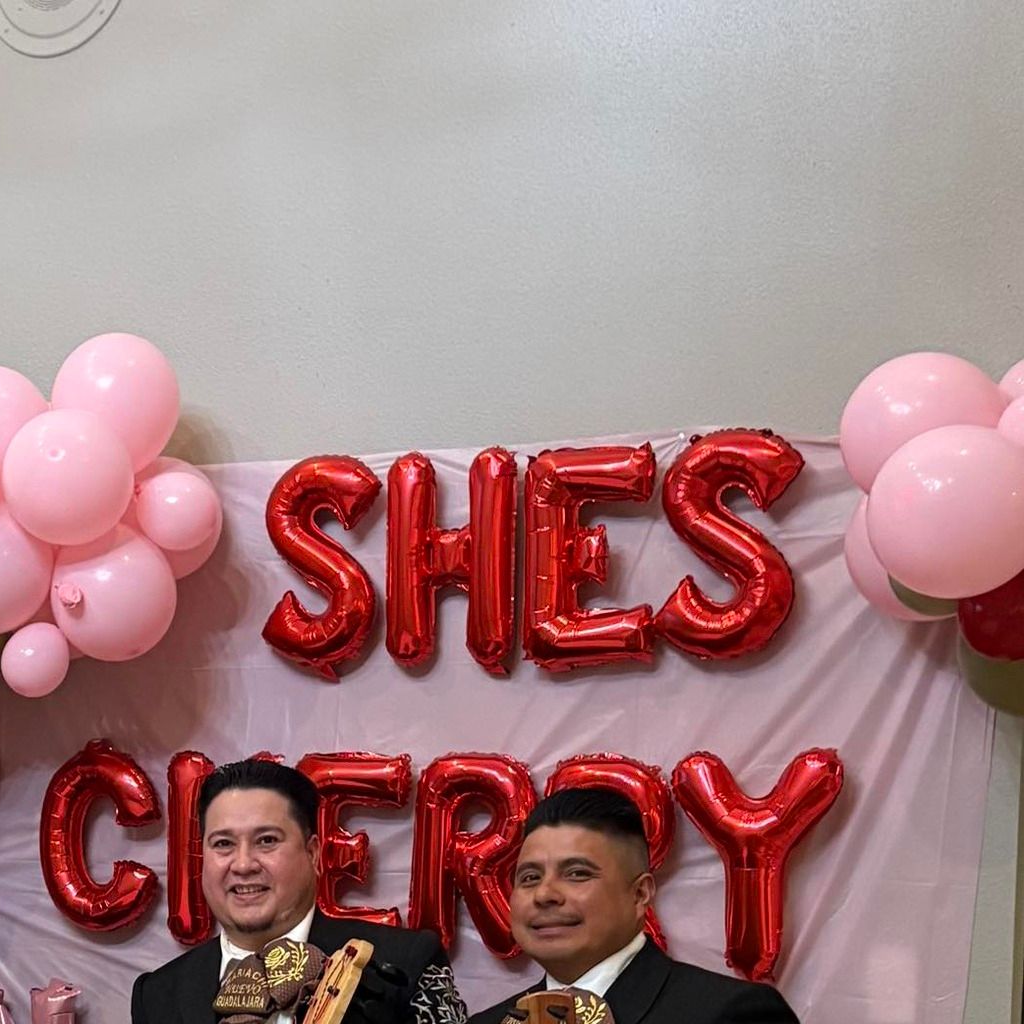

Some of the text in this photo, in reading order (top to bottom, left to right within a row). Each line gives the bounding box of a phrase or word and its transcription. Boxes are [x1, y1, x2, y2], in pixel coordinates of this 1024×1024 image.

[261, 428, 806, 682] SHES
[224, 983, 262, 996] NUEVO
[216, 995, 265, 1009] GUADALAJARA
